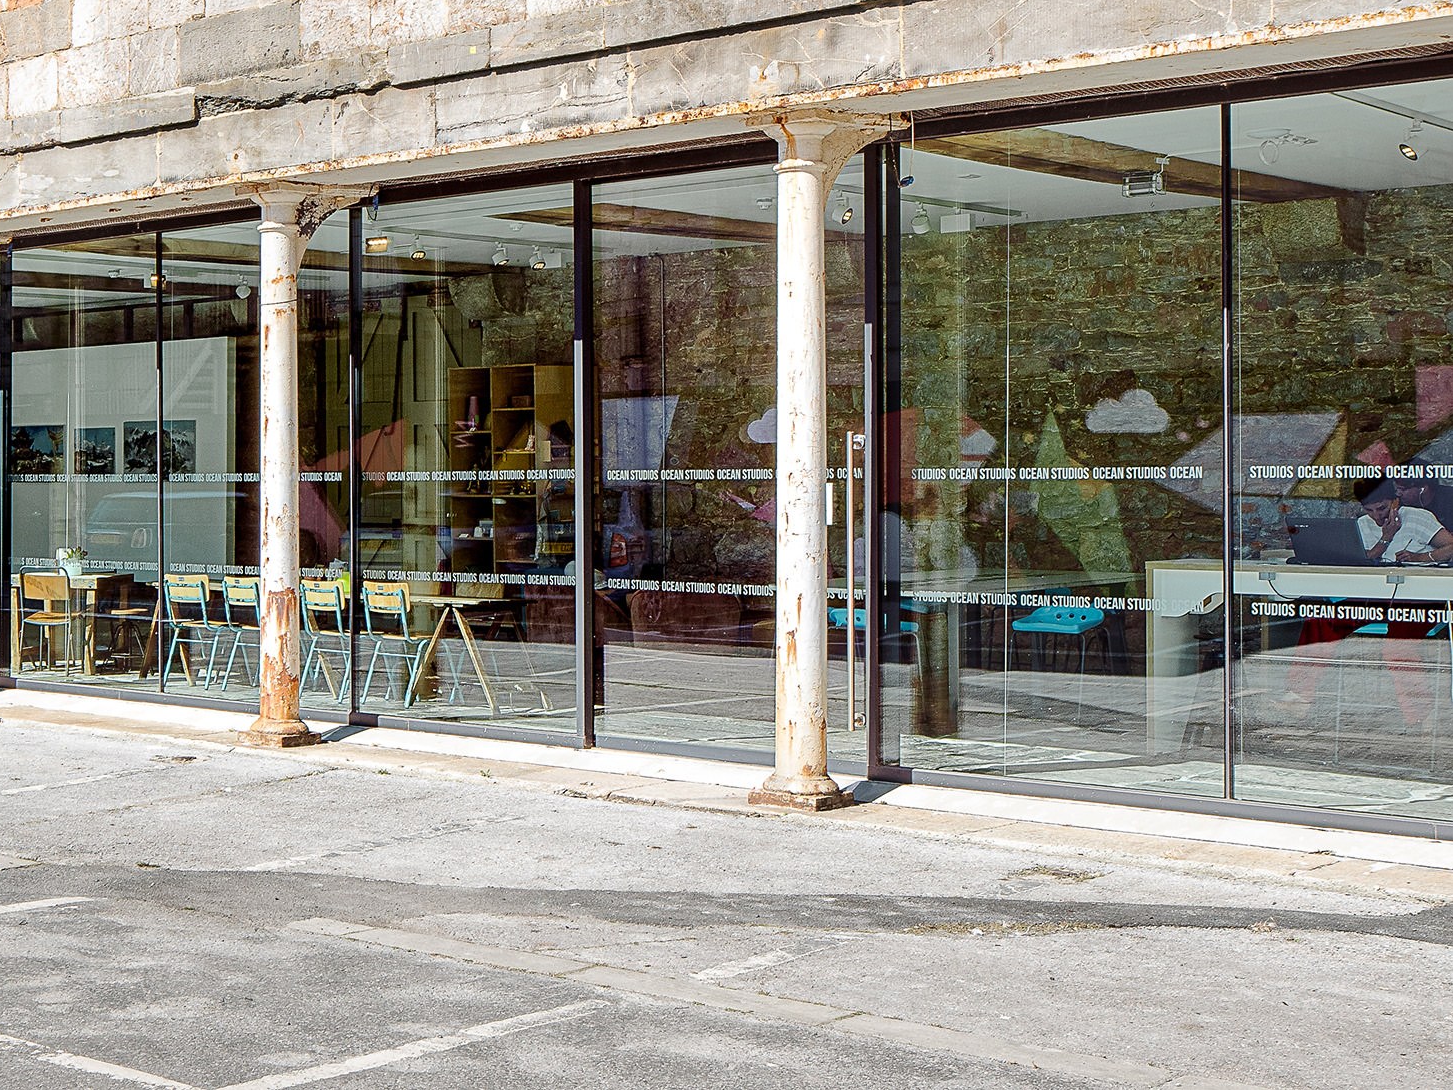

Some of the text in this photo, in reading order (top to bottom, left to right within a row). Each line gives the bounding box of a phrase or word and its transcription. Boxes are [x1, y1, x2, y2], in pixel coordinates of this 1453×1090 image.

[25, 474, 38, 482] OCEAN
[38, 474, 56, 482] STUDIOS
[89, 473, 104, 482] OCEAN
[104, 473, 123, 482] STUDIOS
[124, 473, 138, 482] OCEAN
[139, 473, 158, 482] STUDIOS
[169, 473, 185, 482] OCEAN
[185, 473, 205, 482] STUDIOS
[205, 473, 222, 482] OCEAN
[222, 473, 243, 482] STUDIOS
[300, 471, 343, 482] STUDIOS OCEAN
[362, 468, 575, 482] STUDIOS OCEAN STUDIOS OCEAN STUDIOS OCEAN STUDIOS OCEAN STUDIOS
[607, 468, 773, 481] OCEAN STUDIOS OCEAN STUDIOS OCEAN STUDIOS
[836, 468, 863, 479] OCAN
[911, 466, 1203, 480] STUDIOS OCEAN STUDIOS OCEAN STUDIOS OCEAN STUDIOS OCEAN
[1249, 465, 1294, 479] STUDIOS
[1297, 465, 1334, 479] OCEAN
[1335, 465, 1382, 479] STUDIOS
[1386, 465, 1424, 479] OCEAN
[25, 557, 39, 566] OCEAN
[90, 560, 105, 569] OCEAN
[105, 561, 124, 570] STUDIOS
[124, 561, 139, 570] OCEAN
[139, 562, 159, 571] STUDIOS
[169, 563, 186, 572] OCEAN
[185, 563, 206, 573] STUDIOS
[206, 564, 223, 574] OCEAN
[223, 565, 244, 575] STUDIOS
[301, 568, 343, 579] STUDIOS OCEAN
[362, 569, 576, 586] STUDIOS OCEAN STUDIOS OCEAN STUDIOS OCEAN STUDIOS OCEAN STUDIOS
[607, 578, 774, 597] OCEAN STUDIOS OCEAN STUDIOS OCEAN STUDIOS
[950, 591, 979, 604] OCEAN
[980, 592, 1018, 606] STUDIOS
[1020, 593, 1051, 607] OCEAN
[1052, 595, 1091, 609] STUDIOS
[1094, 596, 1125, 611] OCEAN
[1127, 597, 1167, 612] STUDIOS
[1251, 602, 1296, 617] STUDIOS
[1299, 604, 1335, 619] OCEAN
[1337, 605, 1384, 621] STUDIOS
[1387, 607, 1426, 623] OCEAN
